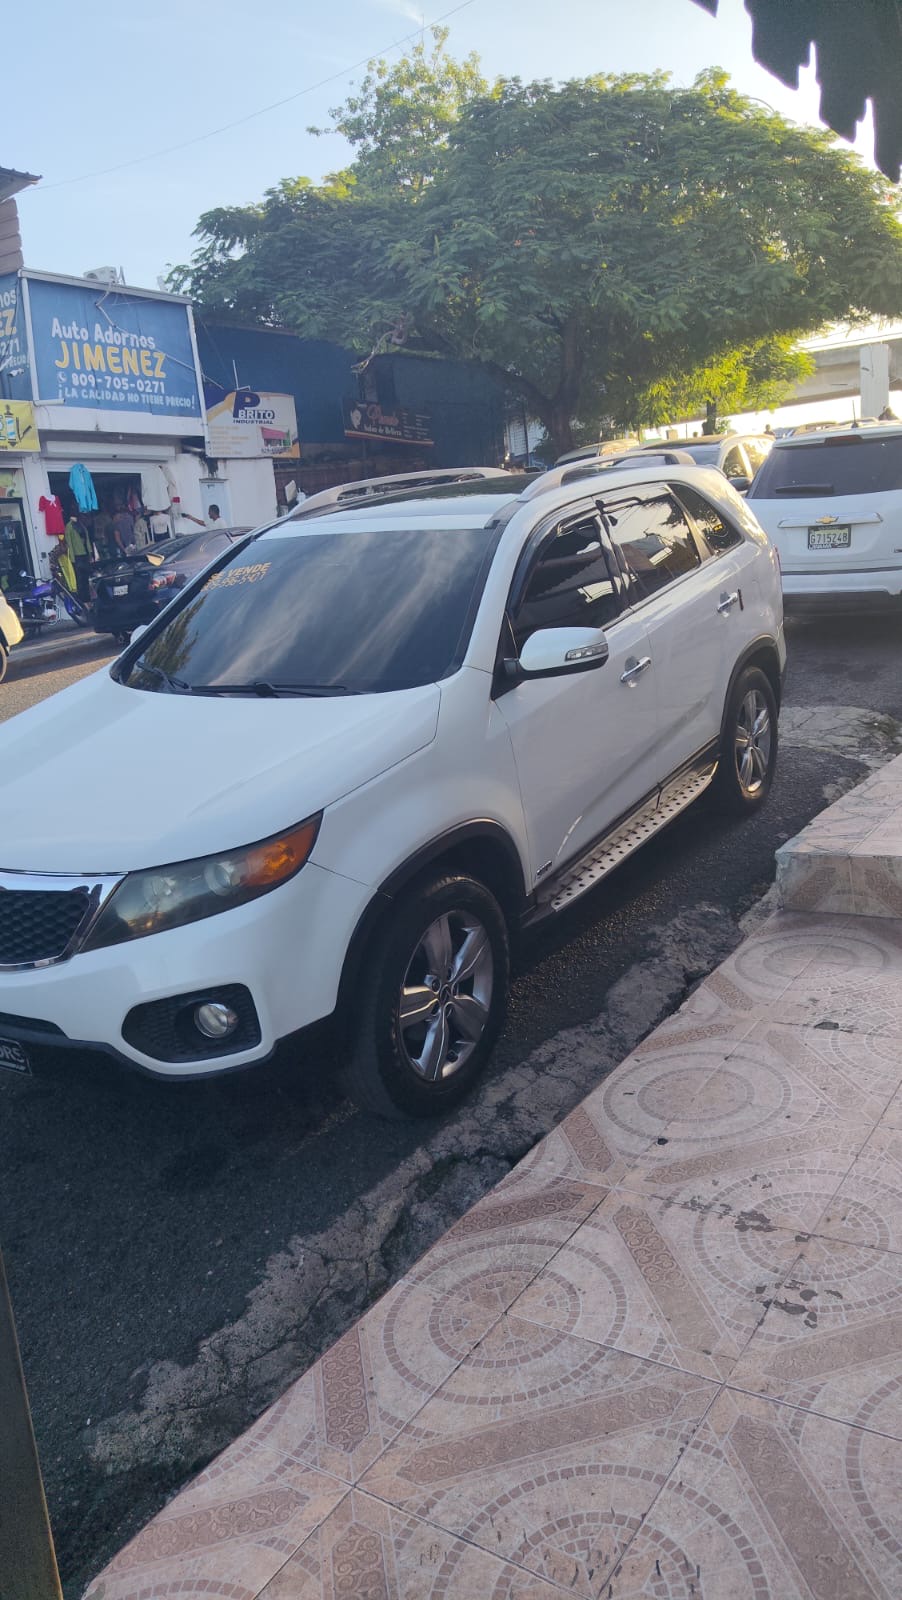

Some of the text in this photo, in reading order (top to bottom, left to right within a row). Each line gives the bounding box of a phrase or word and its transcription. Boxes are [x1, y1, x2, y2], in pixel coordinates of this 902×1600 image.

[52, 317, 156, 350] Auto Adornos
[55, 341, 167, 379] JIMENEZ
[71, 372, 165, 394] 809-705-0271
[81, 390, 126, 402] CALIDAD
[127, 393, 140, 404] NO
[141, 394, 164, 406] TIENE
[165, 395, 196, 410] PRECIO!
[238, 408, 275, 420] BRITO
[228, 561, 272, 578] VENDE
